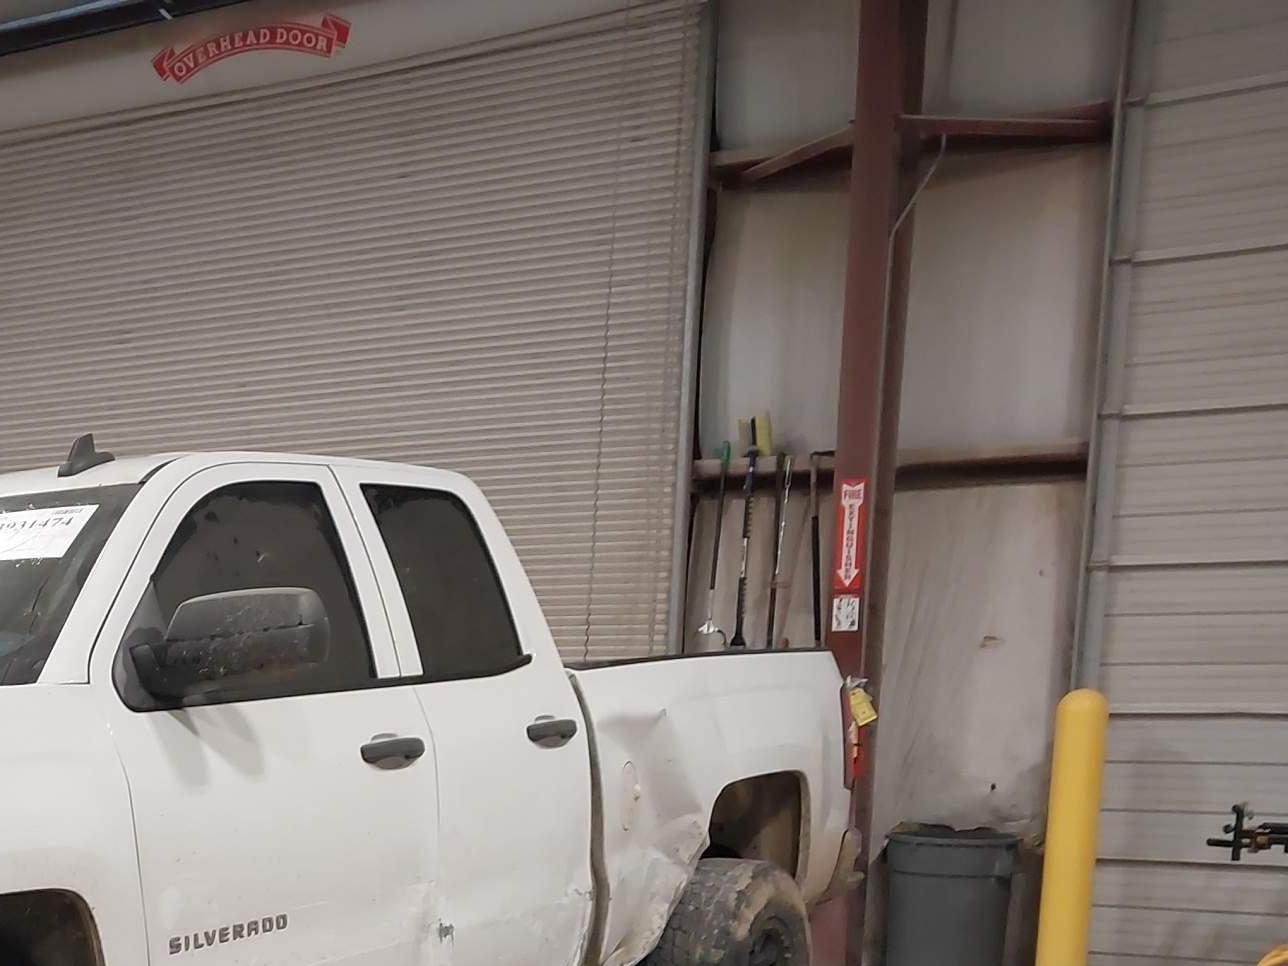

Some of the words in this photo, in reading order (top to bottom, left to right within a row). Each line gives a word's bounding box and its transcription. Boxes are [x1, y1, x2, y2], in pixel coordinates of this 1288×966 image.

[173, 28, 270, 77] OVERHEAD
[275, 28, 328, 53] DOOR
[843, 489, 862, 500] FIRE
[168, 913, 288, 955] SILVERADO
